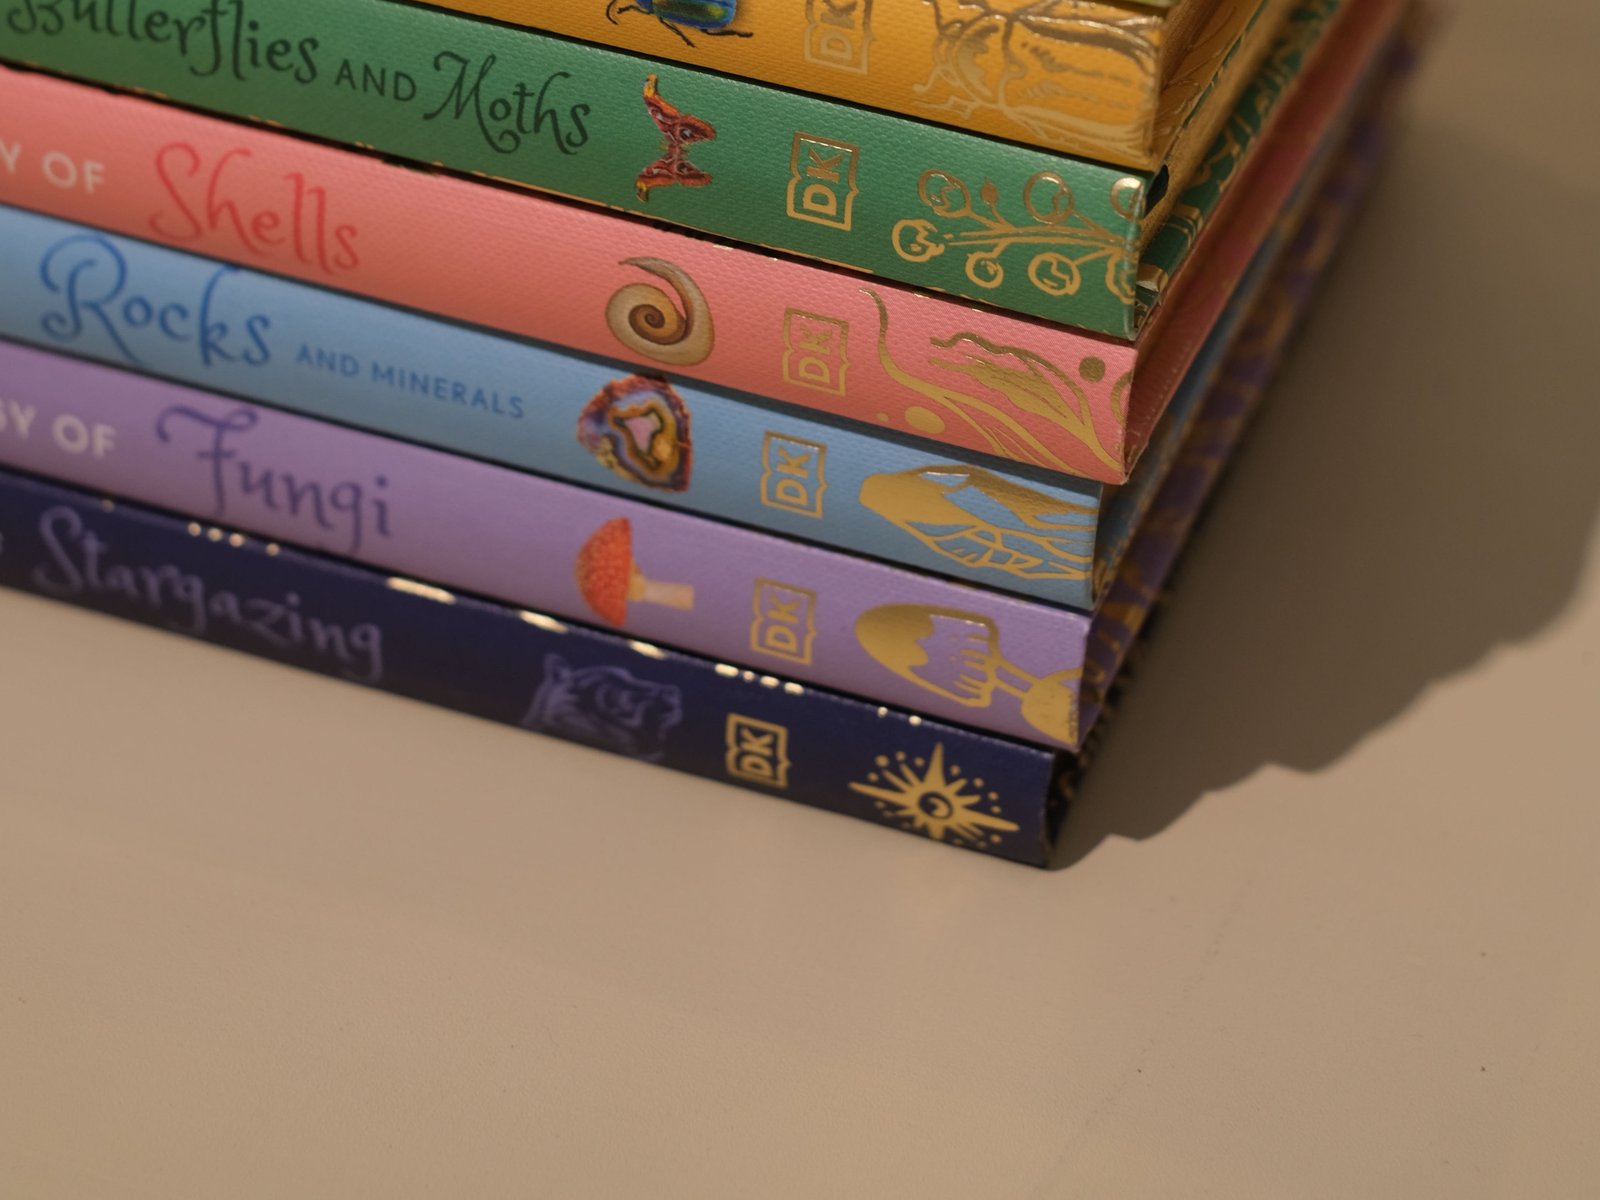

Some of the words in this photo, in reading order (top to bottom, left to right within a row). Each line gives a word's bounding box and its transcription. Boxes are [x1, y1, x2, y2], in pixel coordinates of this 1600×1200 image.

[335, 59, 416, 102] AND
[423, 51, 591, 156] Moths
[42, 150, 104, 193] OF
[148, 142, 360, 275] Shells
[40, 234, 270, 367] Rocks
[296, 344, 359, 377] AND
[372, 362, 525, 419] MINERALS
[52, 413, 117, 459] OF
[155, 403, 391, 557] Fungi
[33, 506, 383, 683] Stargazing
